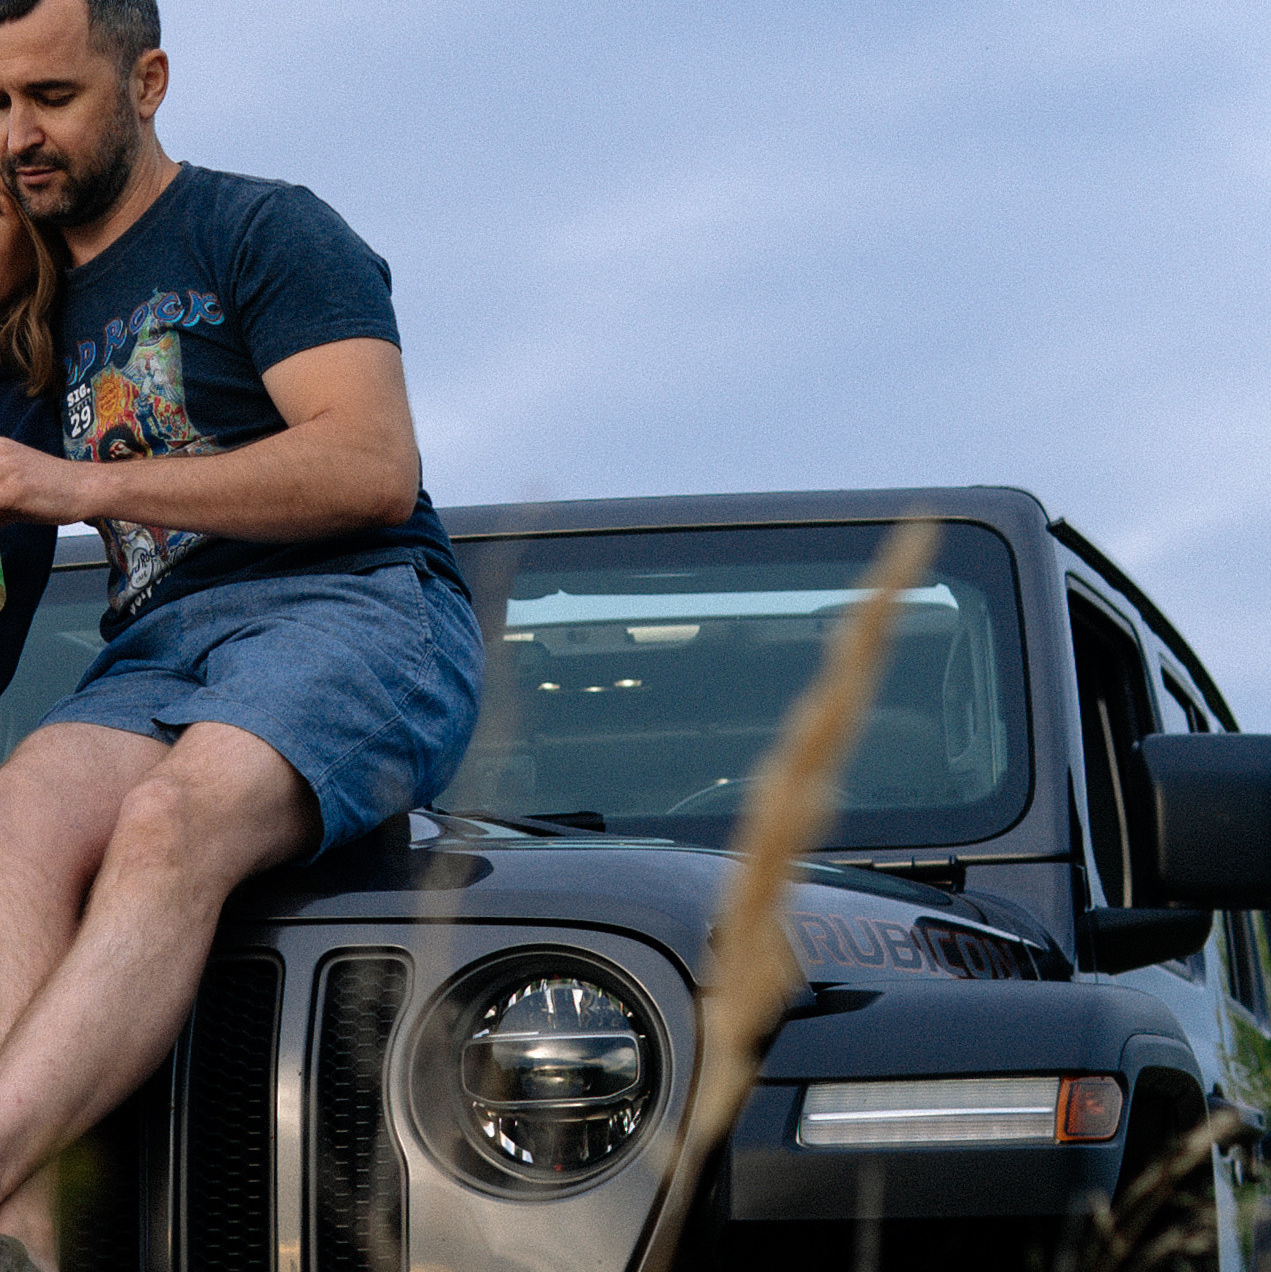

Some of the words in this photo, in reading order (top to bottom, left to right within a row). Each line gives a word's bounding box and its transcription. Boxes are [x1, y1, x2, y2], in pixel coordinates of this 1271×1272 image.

[101, 289, 225, 366] ROCK
[70, 405, 91, 438] 29
[781, 911, 1024, 980] RUBICON
